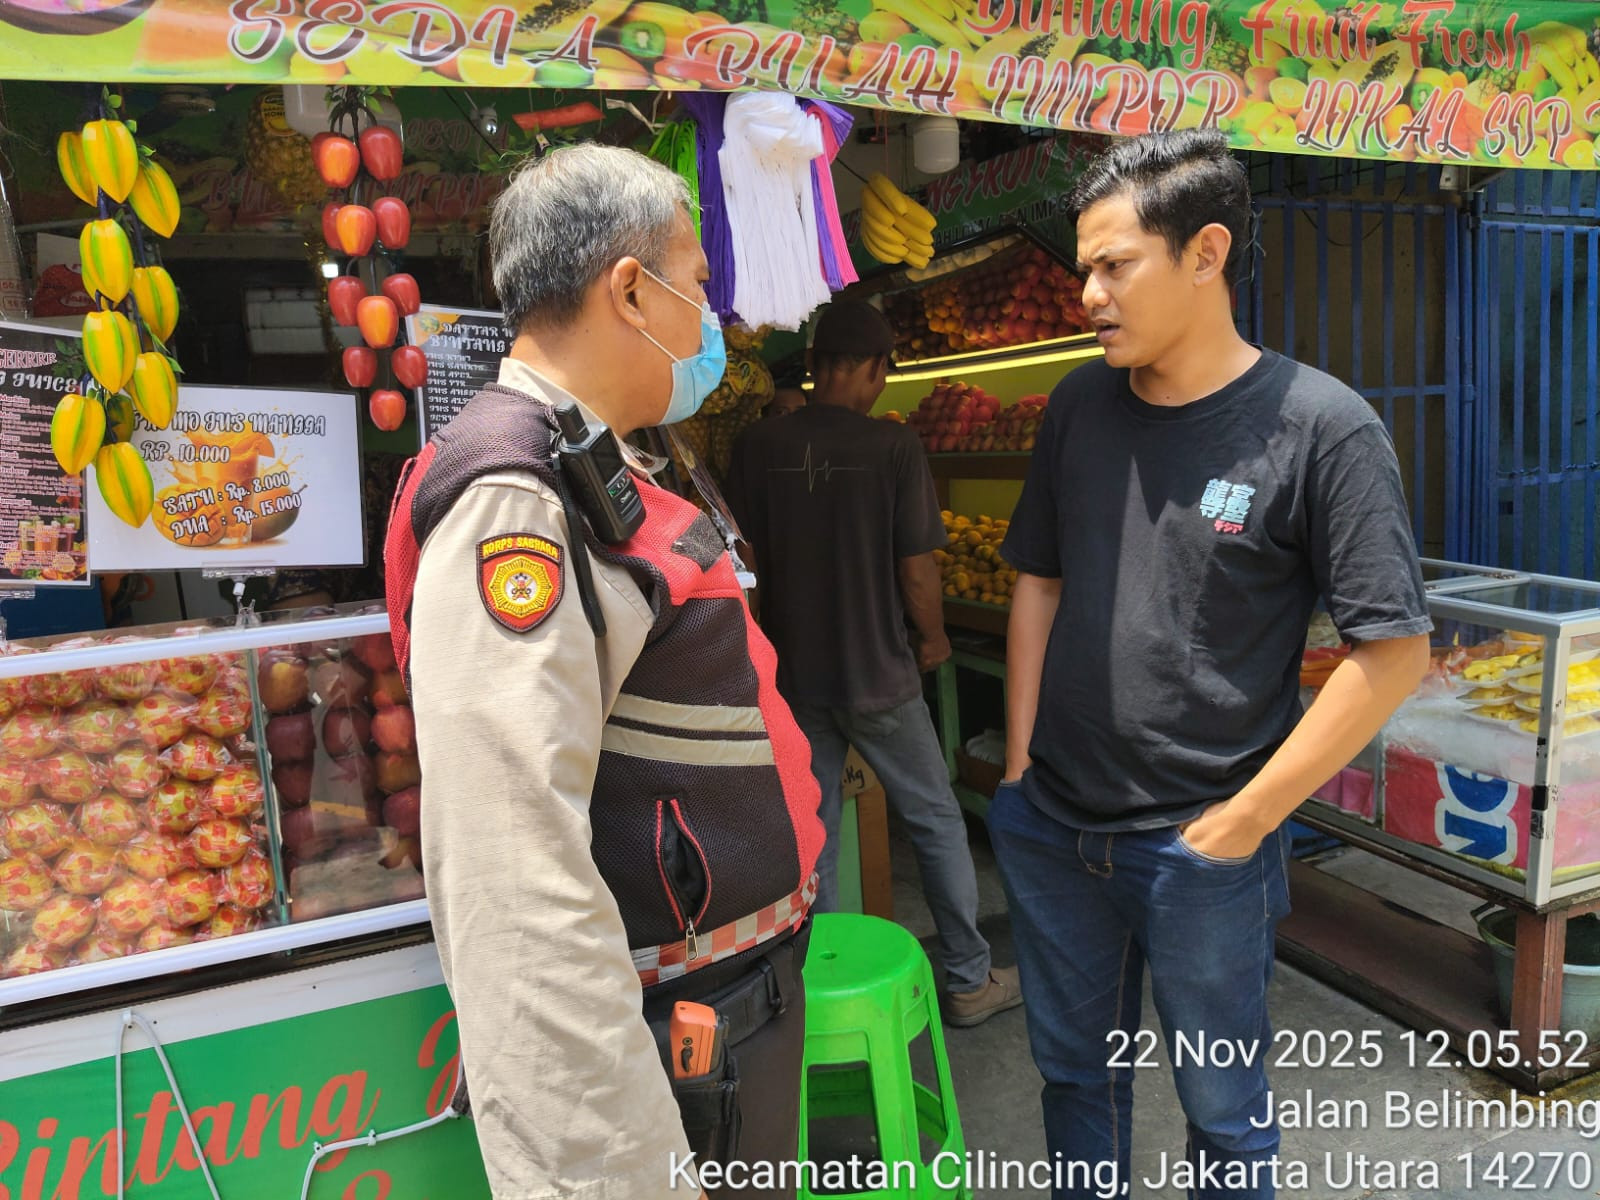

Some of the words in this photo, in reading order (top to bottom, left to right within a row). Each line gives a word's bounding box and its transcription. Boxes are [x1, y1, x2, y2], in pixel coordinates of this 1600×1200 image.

[1483, 92, 1572, 161] SOP
[442, 322, 499, 336] DAFTAR
[203, 410, 245, 434] JUS
[247, 412, 327, 438] MANGGA
[178, 443, 231, 464] 10.000
[162, 487, 215, 516] SATU
[251, 470, 291, 494] 8.000
[171, 514, 210, 540] DUA
[259, 492, 303, 517] 15.000
